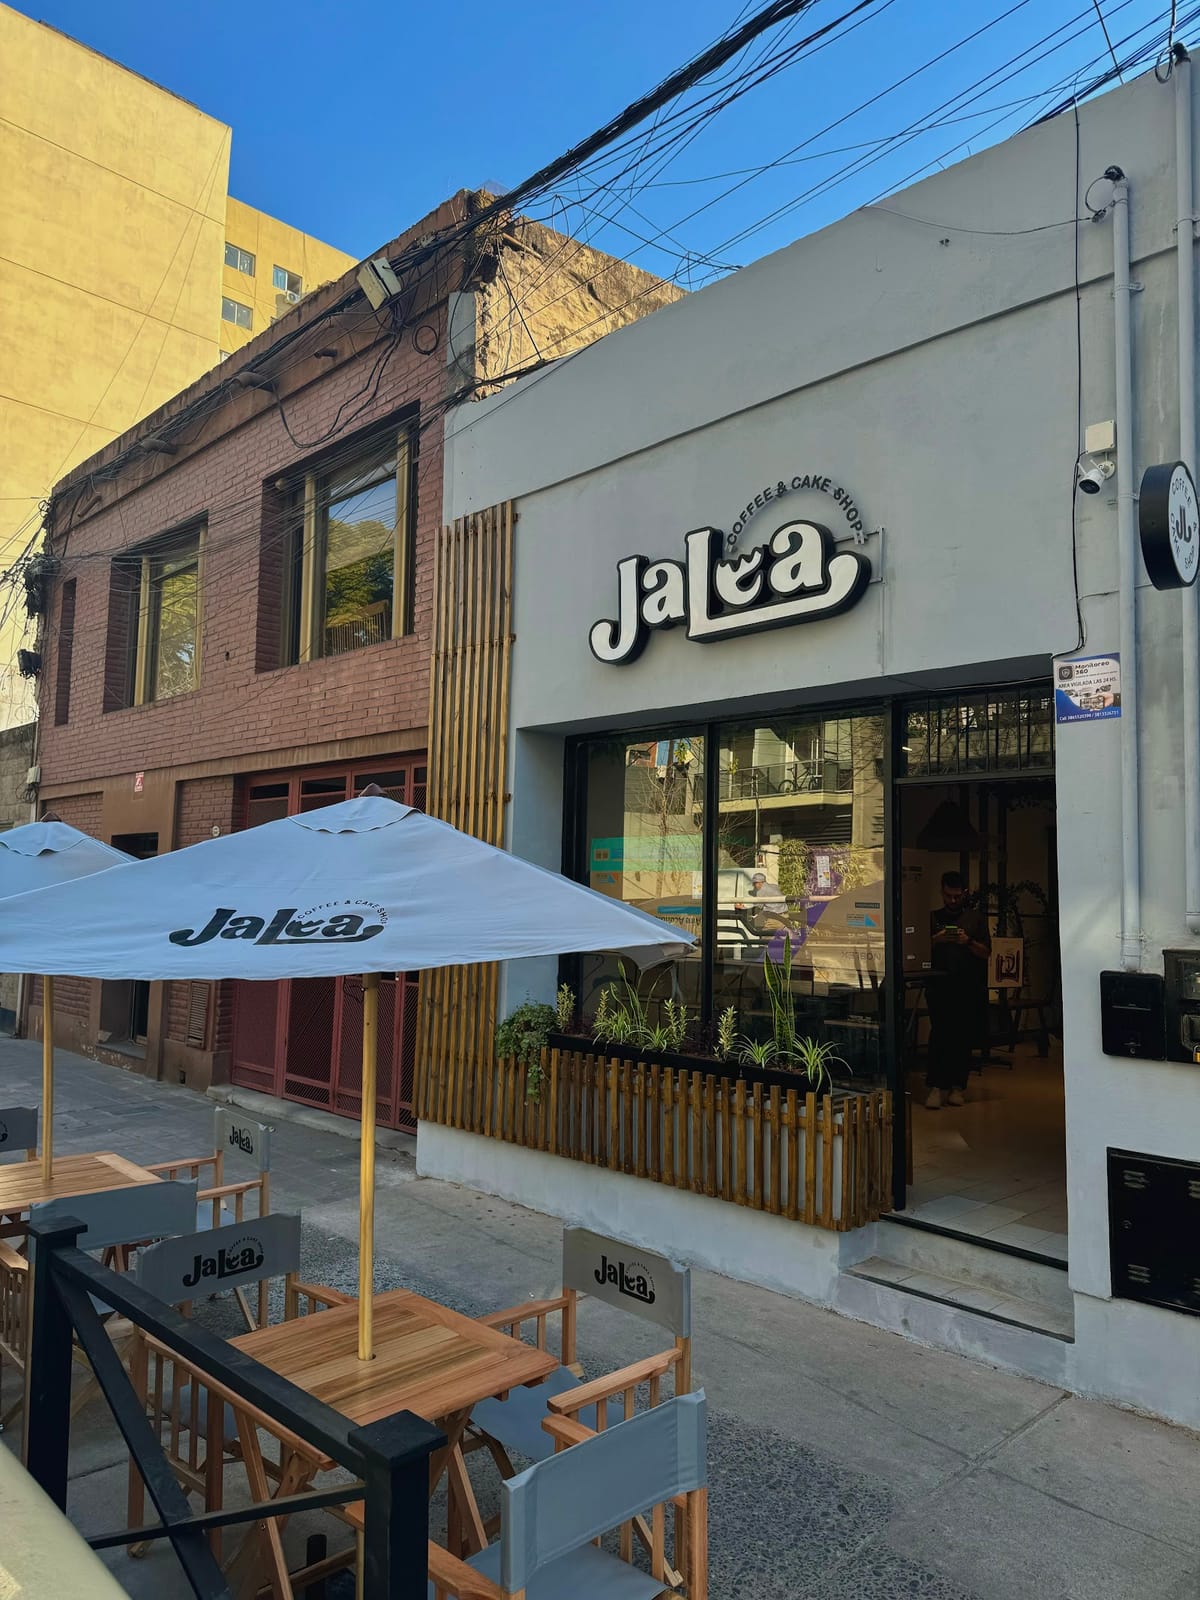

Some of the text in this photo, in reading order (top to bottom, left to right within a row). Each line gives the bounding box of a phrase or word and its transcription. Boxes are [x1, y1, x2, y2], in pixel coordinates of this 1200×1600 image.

[1171, 478, 1192, 507] COFFEE
[727, 475, 862, 545] COFFEE & CAKE SHOP
[1075, 661, 1110, 669] Monitoreo
[298, 901, 339, 919] COFFEE
